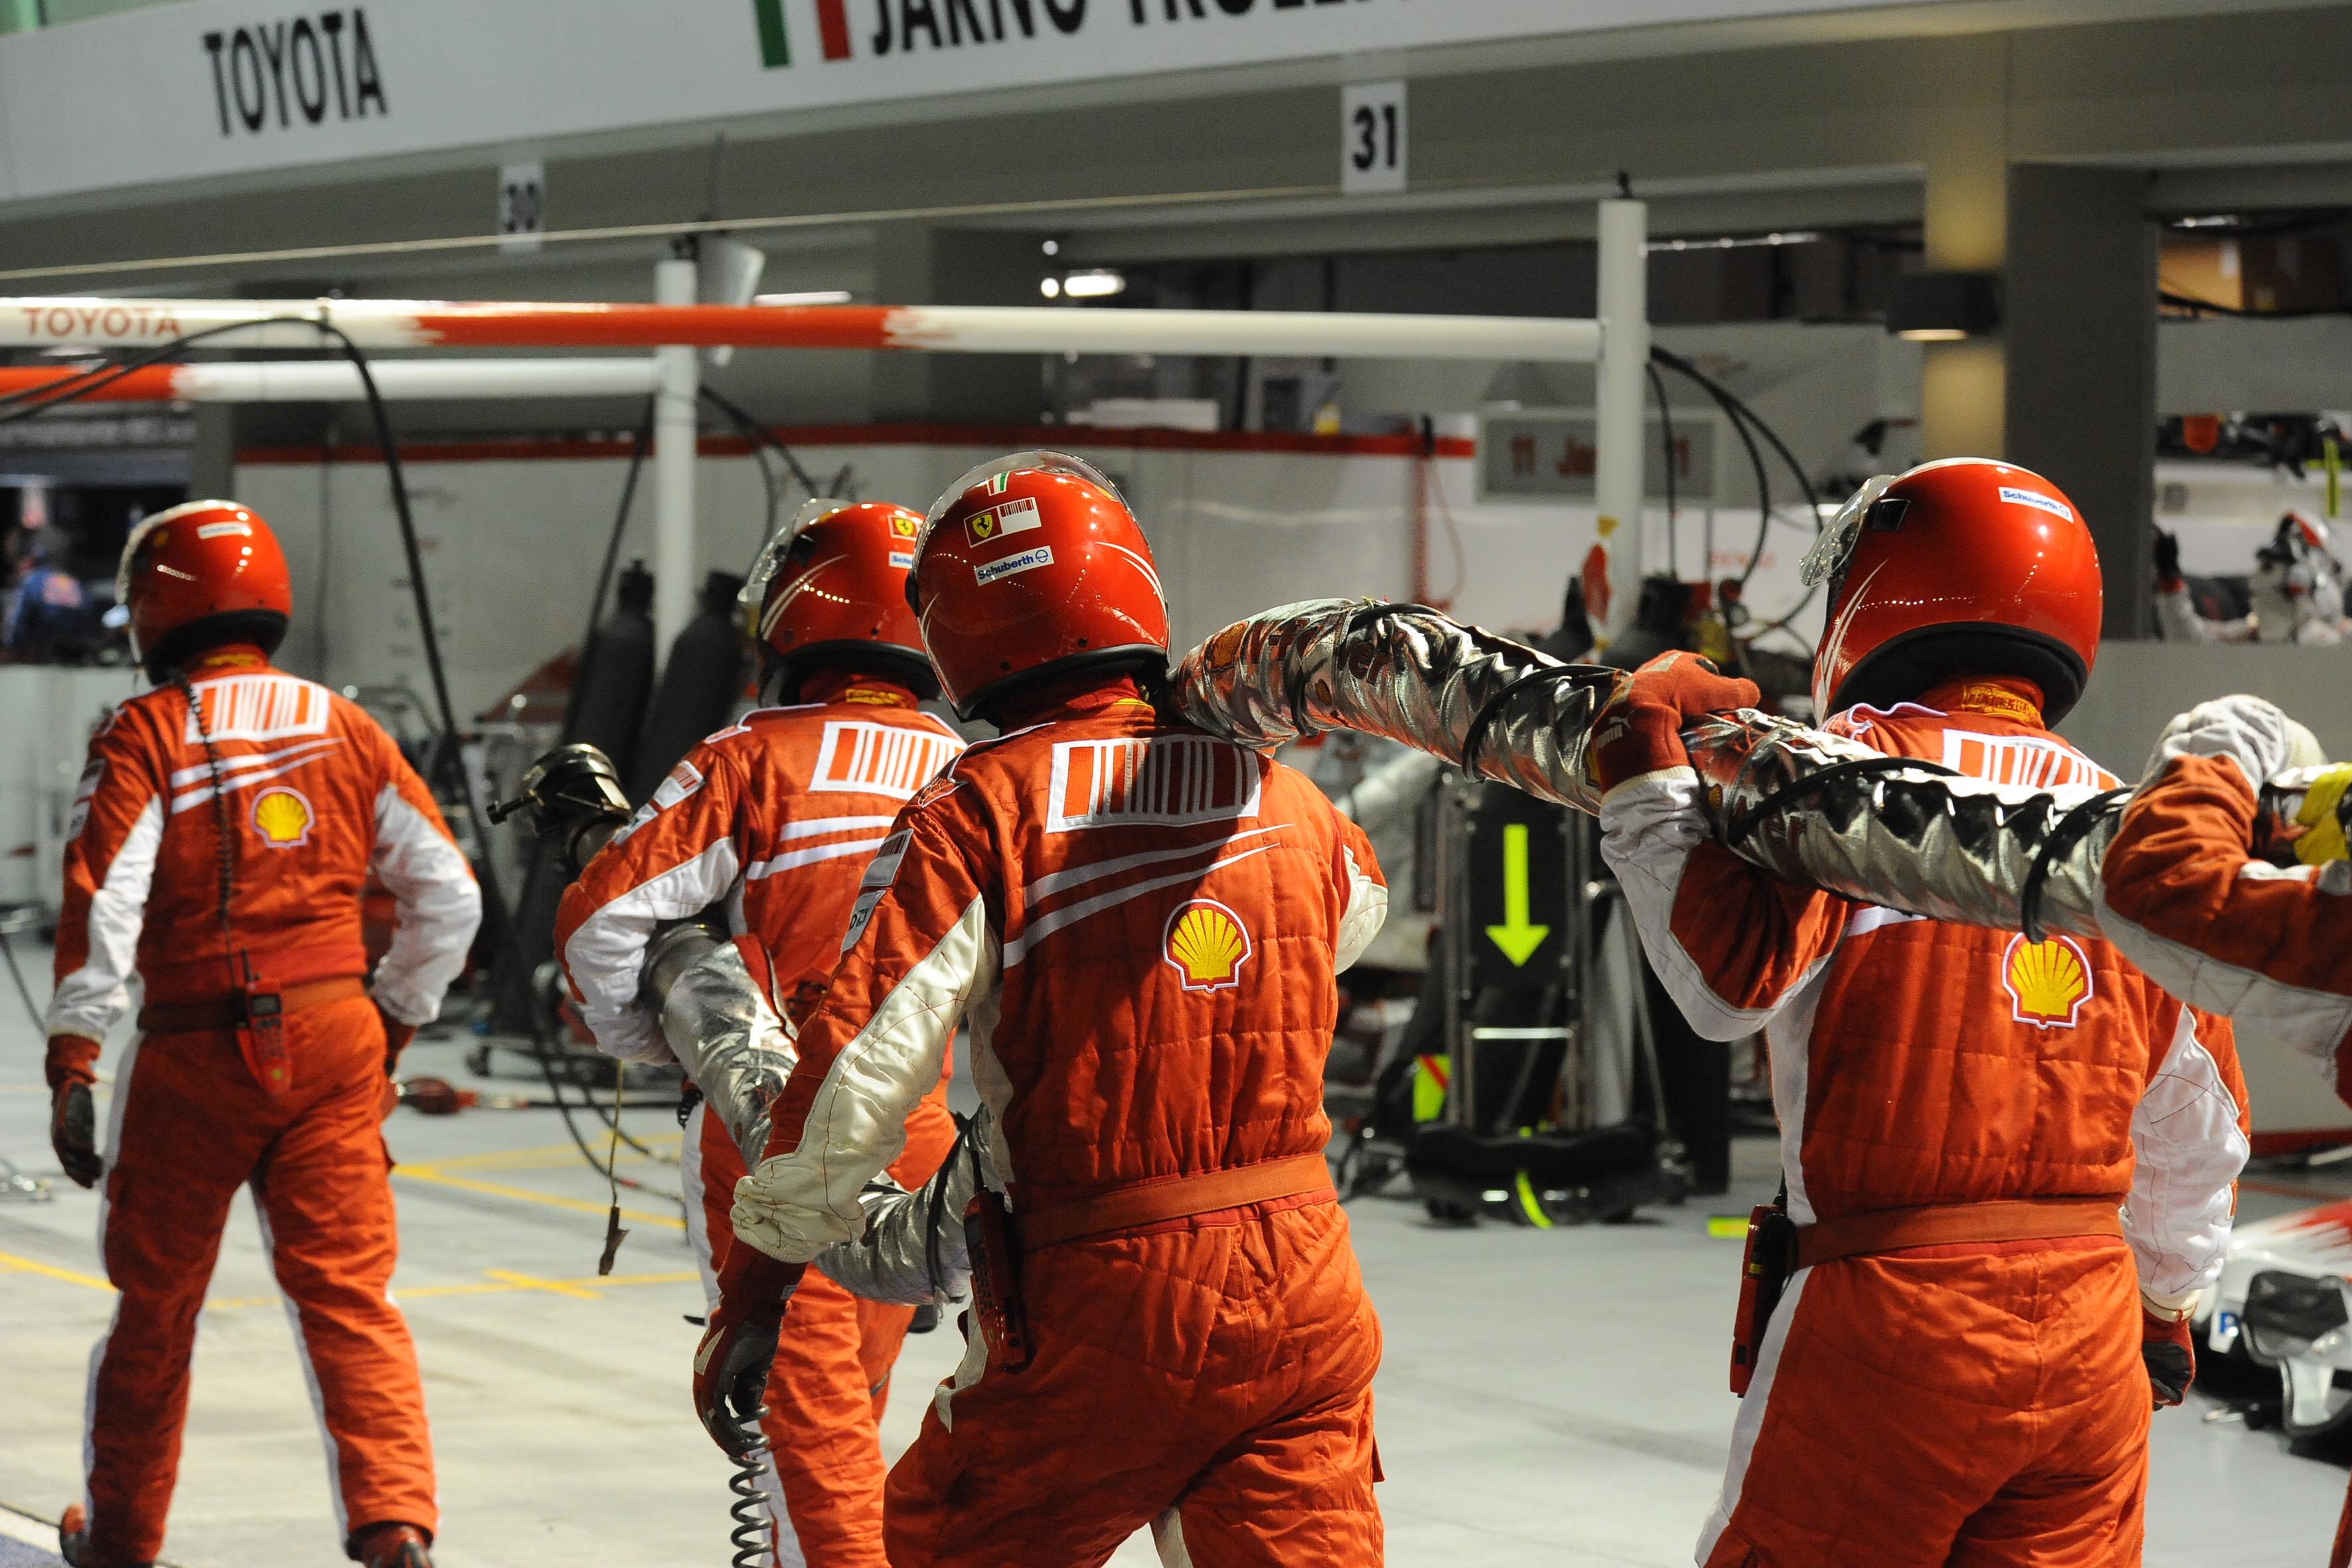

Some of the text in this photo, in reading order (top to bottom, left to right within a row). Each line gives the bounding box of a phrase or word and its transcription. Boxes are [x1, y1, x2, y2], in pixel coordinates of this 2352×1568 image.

[202, 7, 388, 137] TOYOTA
[1352, 104, 1397, 170] 31
[21, 307, 183, 337] TOYOTA
[977, 555, 1034, 580] Schuberth
